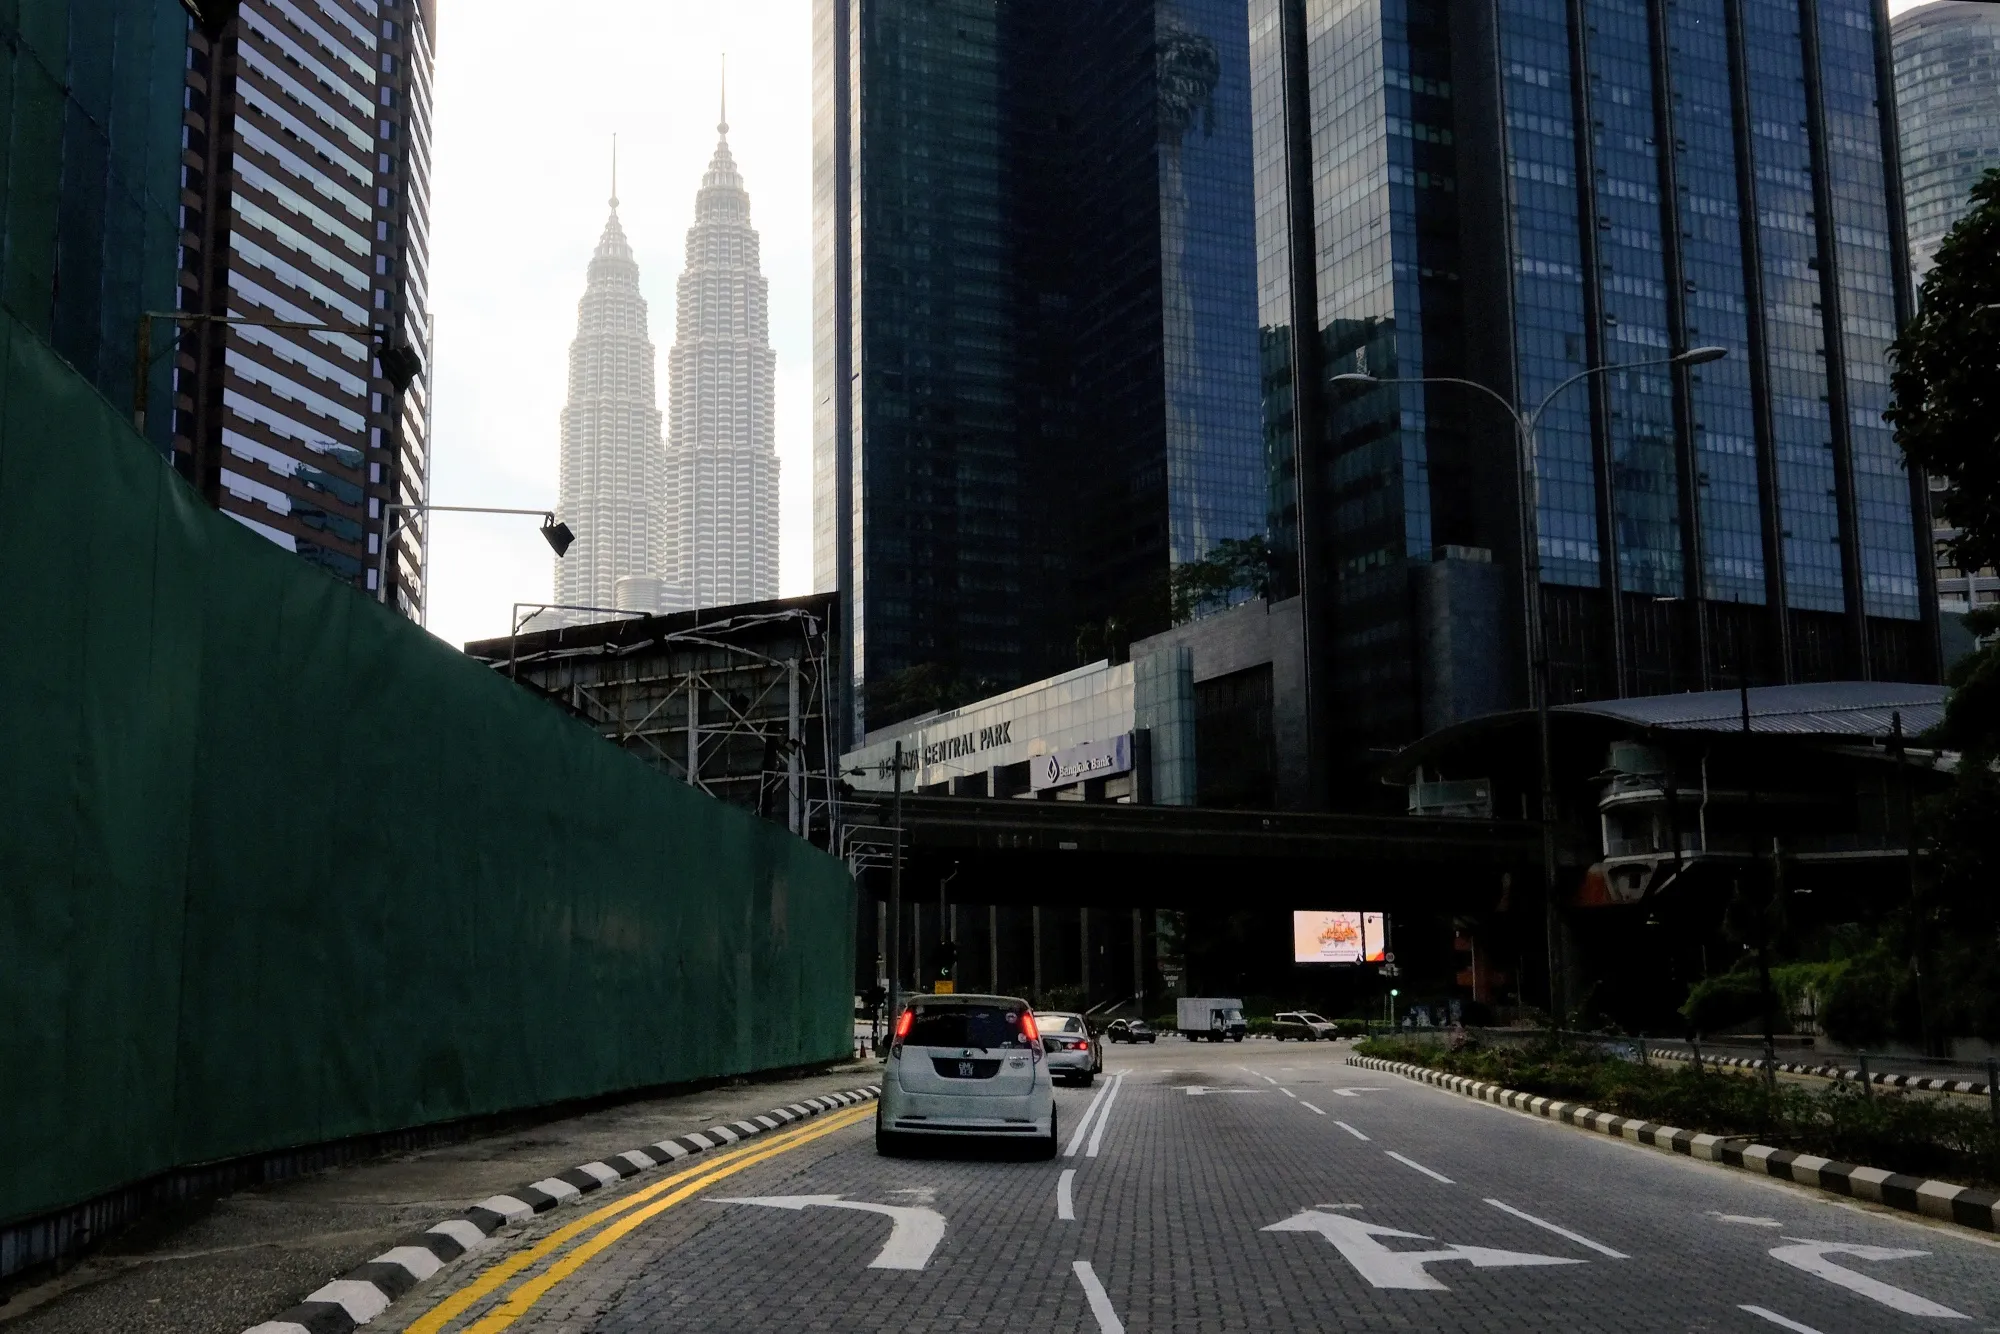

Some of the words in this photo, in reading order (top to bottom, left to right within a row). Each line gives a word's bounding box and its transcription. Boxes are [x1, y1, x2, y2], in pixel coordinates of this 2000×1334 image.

[925, 732, 976, 764] CENTRAL
[980, 720, 1012, 751] PARK
[1060, 760, 1090, 777] Bangkok
[1091, 756, 1111, 770] Bank
